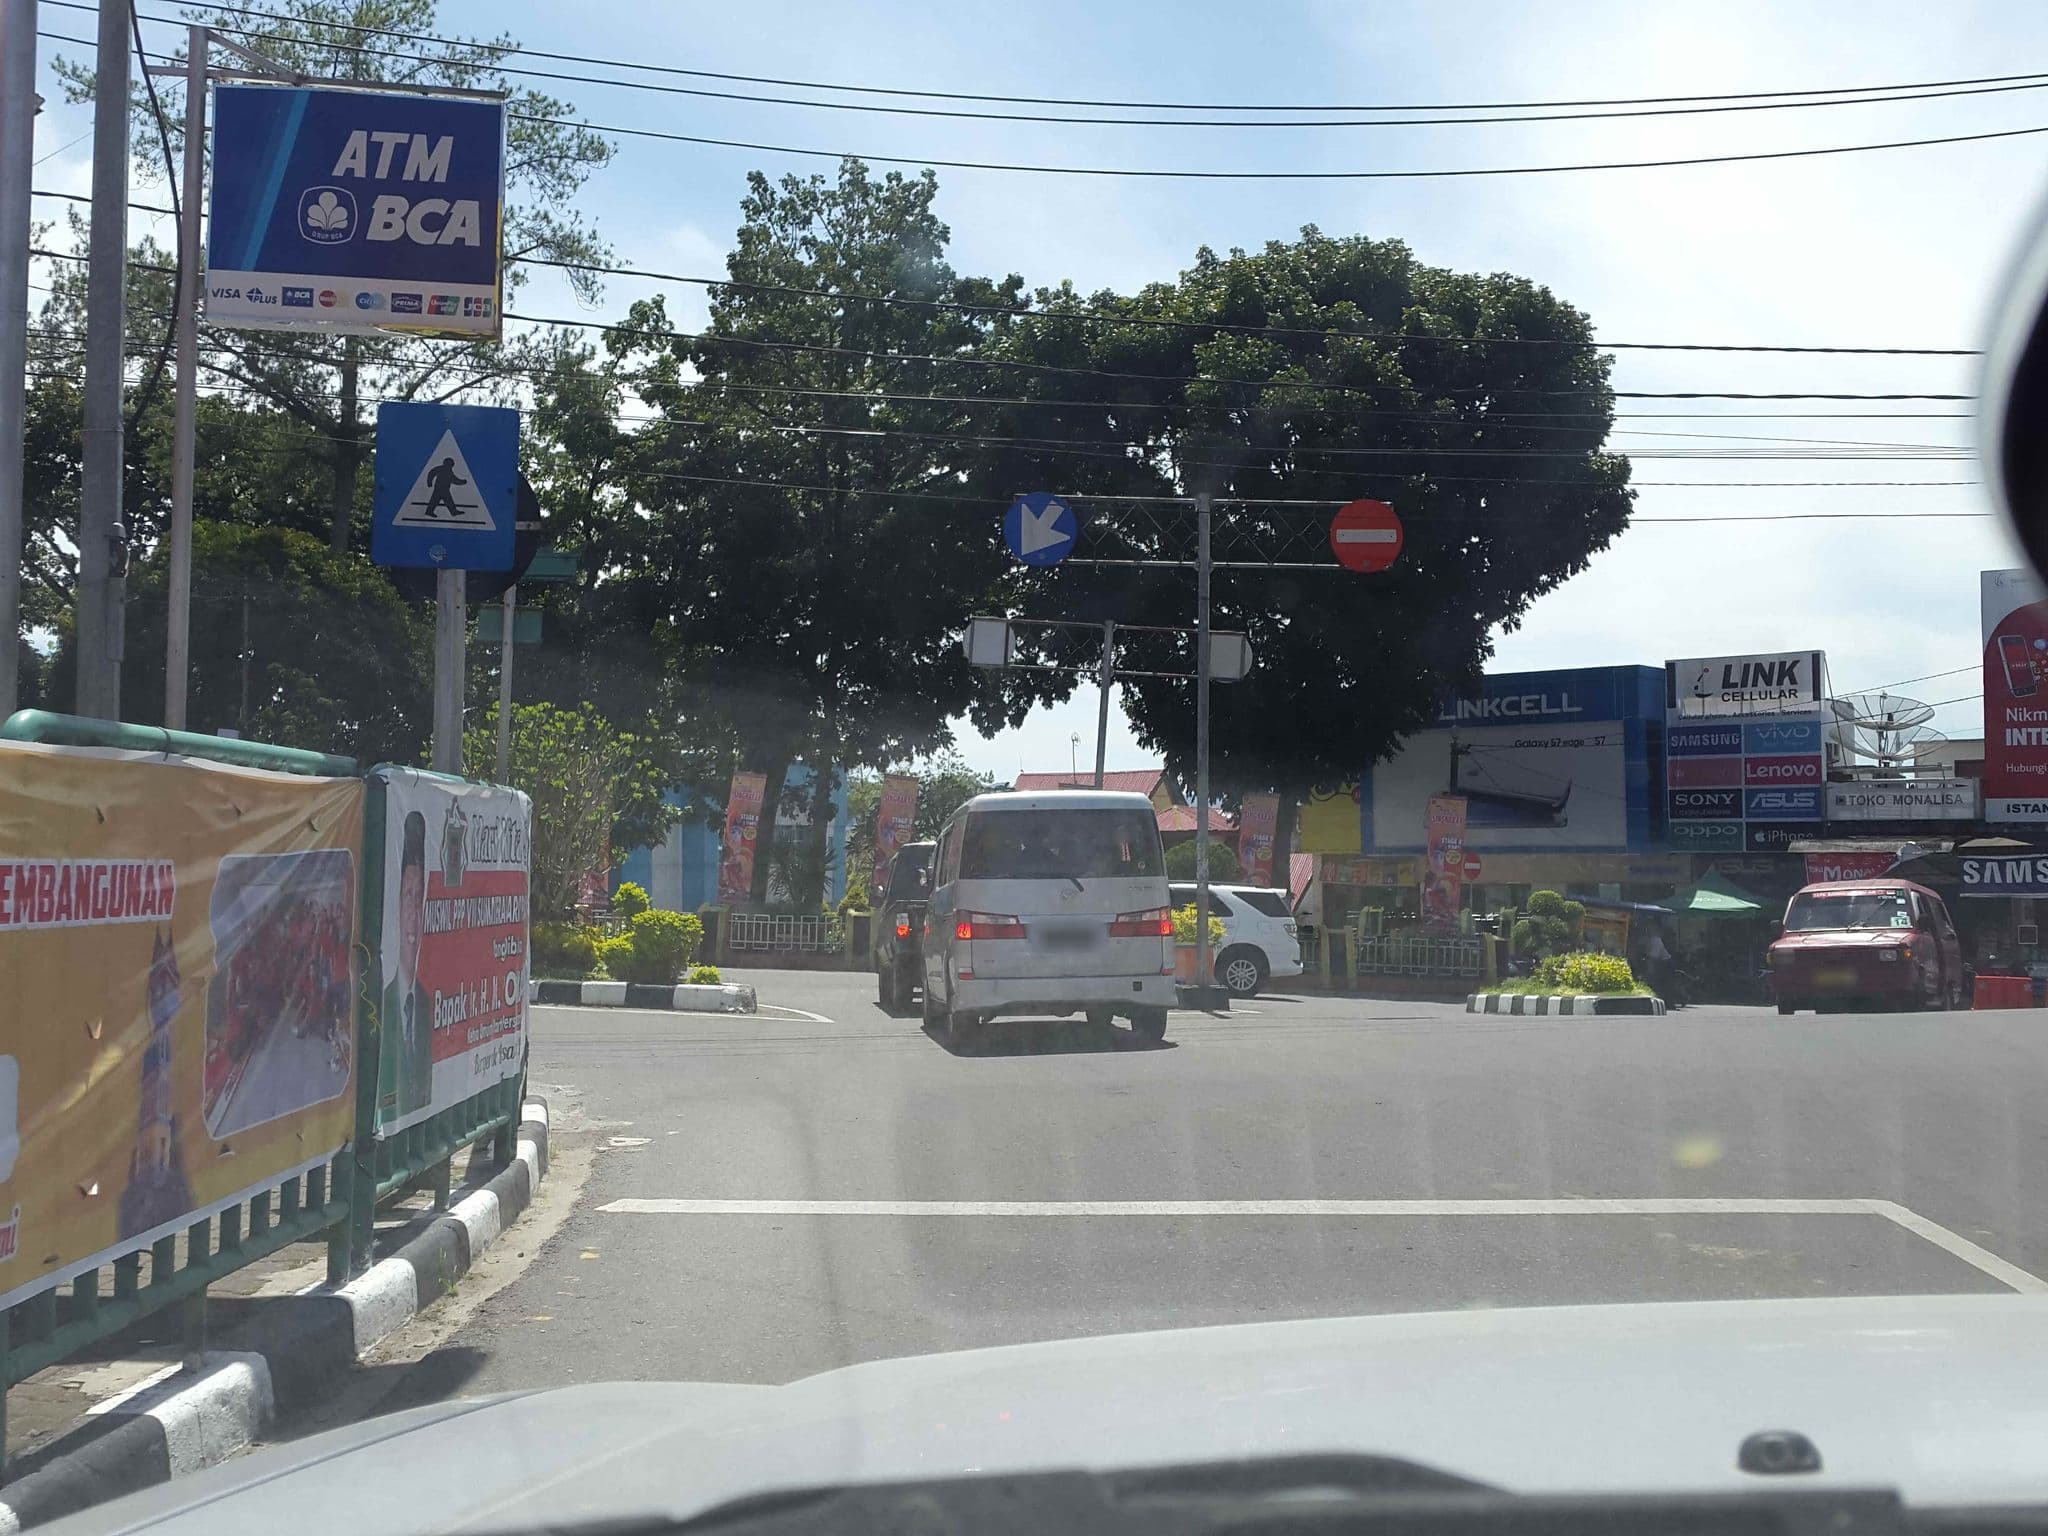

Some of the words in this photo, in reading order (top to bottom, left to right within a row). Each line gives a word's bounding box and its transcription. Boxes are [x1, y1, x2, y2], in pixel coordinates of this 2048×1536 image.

[332, 130, 453, 183] ATM
[366, 195, 480, 246] BCA
[211, 288, 241, 299] VISA
[254, 295, 278, 305] PLUS
[1722, 660, 1800, 689] LINK
[1721, 689, 1798, 702] CELLULAR
[1439, 692, 1583, 720] LINKCELL
[1782, 708, 1812, 716] Services
[1514, 738, 1548, 749] Galaxy
[1671, 732, 1740, 748] SAMSUNG
[1747, 764, 1817, 778] Lenovo
[1675, 793, 1734, 806] SONY
[1750, 793, 1815, 808] ASUS
[1849, 795, 1886, 806] TOKO
[1893, 794, 1964, 806] MONALISA
[1963, 860, 2048, 884] SAMS
[434, 989, 468, 1037] Bapak
[480, 978, 489, 1014] H.
